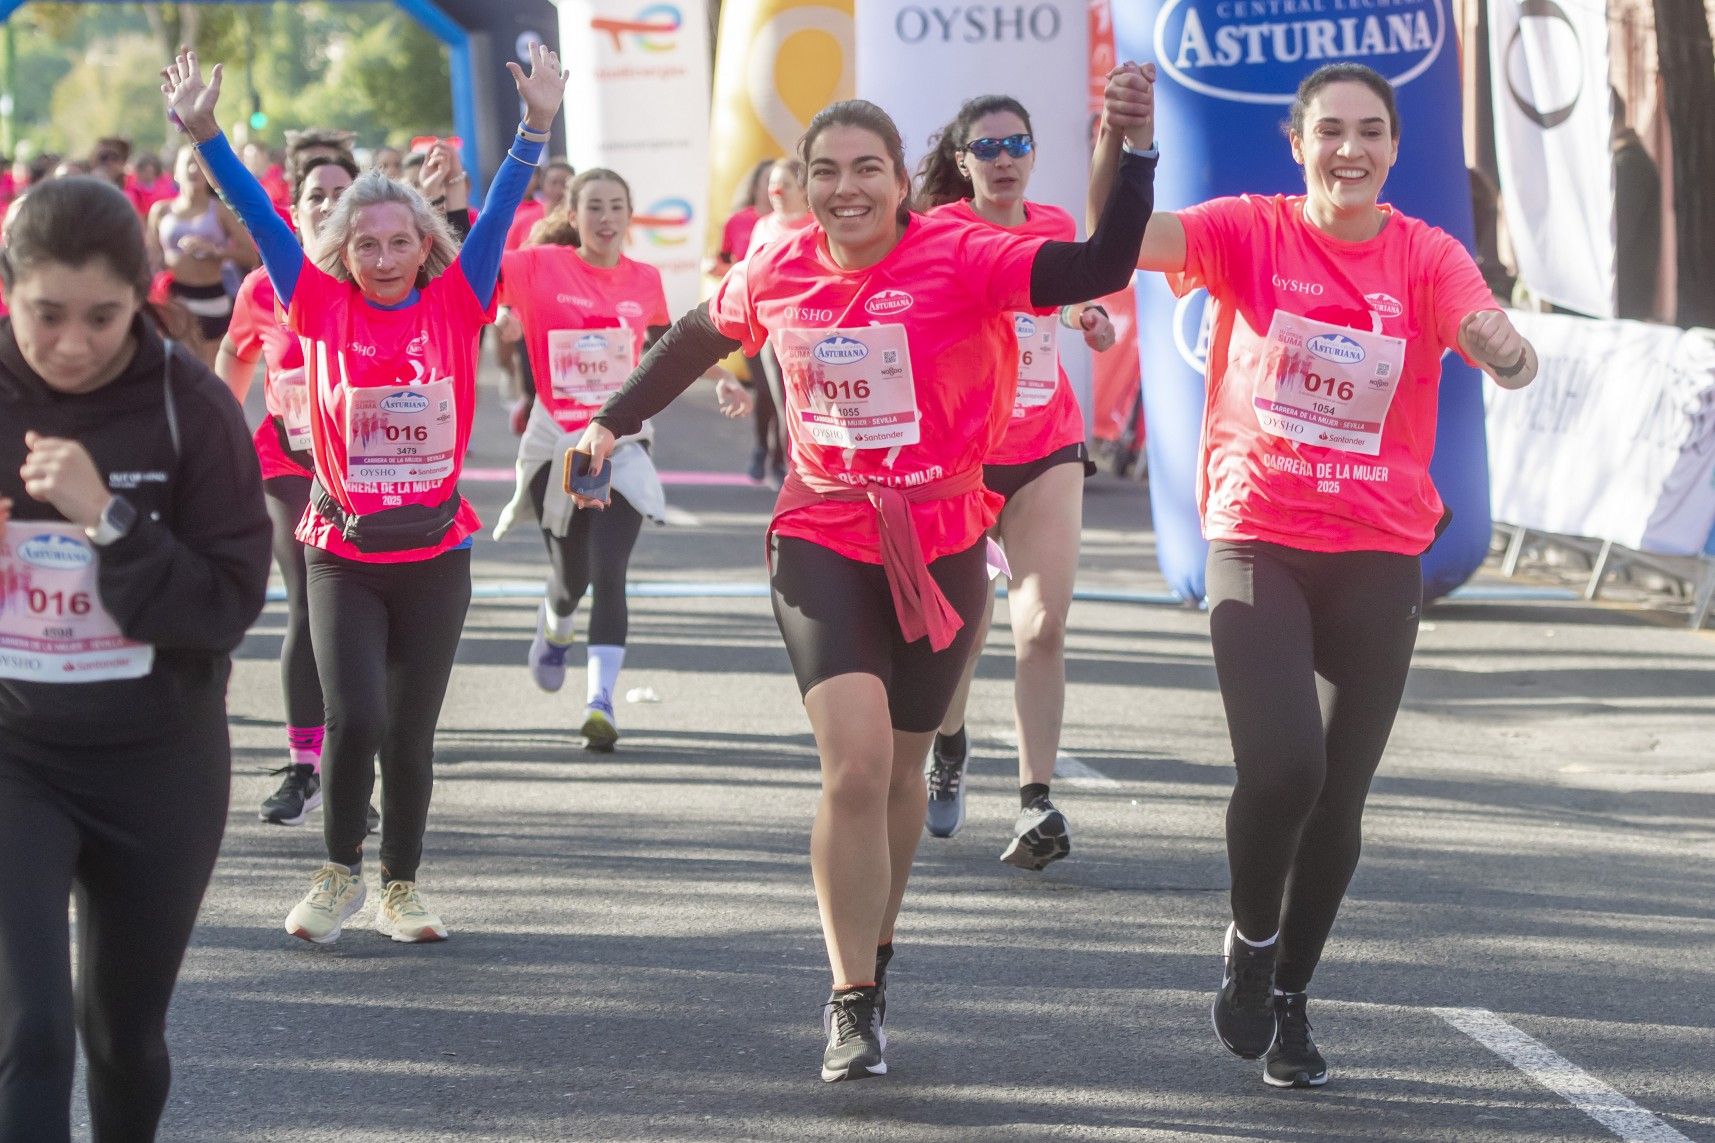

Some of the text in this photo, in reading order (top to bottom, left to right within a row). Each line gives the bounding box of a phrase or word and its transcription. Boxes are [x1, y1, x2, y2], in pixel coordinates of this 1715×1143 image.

[895, 3, 1061, 44] OYSHO
[1174, 7, 1434, 69] ASTURIANA
[869, 299, 910, 311] ASTURIANA
[783, 306, 833, 322] OYSHO
[1278, 333, 1303, 347] SUMA
[351, 341, 376, 356] SHO
[818, 347, 865, 359] ASTURIANA
[1311, 340, 1361, 361] ASTURIANA
[578, 361, 608, 375] 016
[823, 379, 871, 400] 016
[1304, 372, 1354, 400] 016
[384, 400, 427, 410] ASTURIANA
[838, 407, 860, 417] 1055
[1313, 402, 1335, 416] 1054
[872, 415, 898, 425] SEVILLA
[1271, 404, 1298, 417] CARRERA
[1309, 413, 1317, 421] LA
[1318, 416, 1339, 427] MUJER
[1343, 421, 1365, 430] SEVILLA
[385, 425, 428, 441] 016
[812, 427, 904, 442] OYSHO Santander
[1328, 434, 1366, 446] Santander
[396, 447, 417, 455] 3479
[360, 466, 448, 477] OYSHO Santander
[1263, 453, 1389, 482] CARRERA DE LA MUJER
[904, 465, 943, 487] MUJER
[380, 481, 396, 494] DE
[397, 481, 411, 494] LA
[1316, 480, 1340, 493] 2025
[382, 494, 402, 506] 2025
[28, 587, 91, 616] 016
